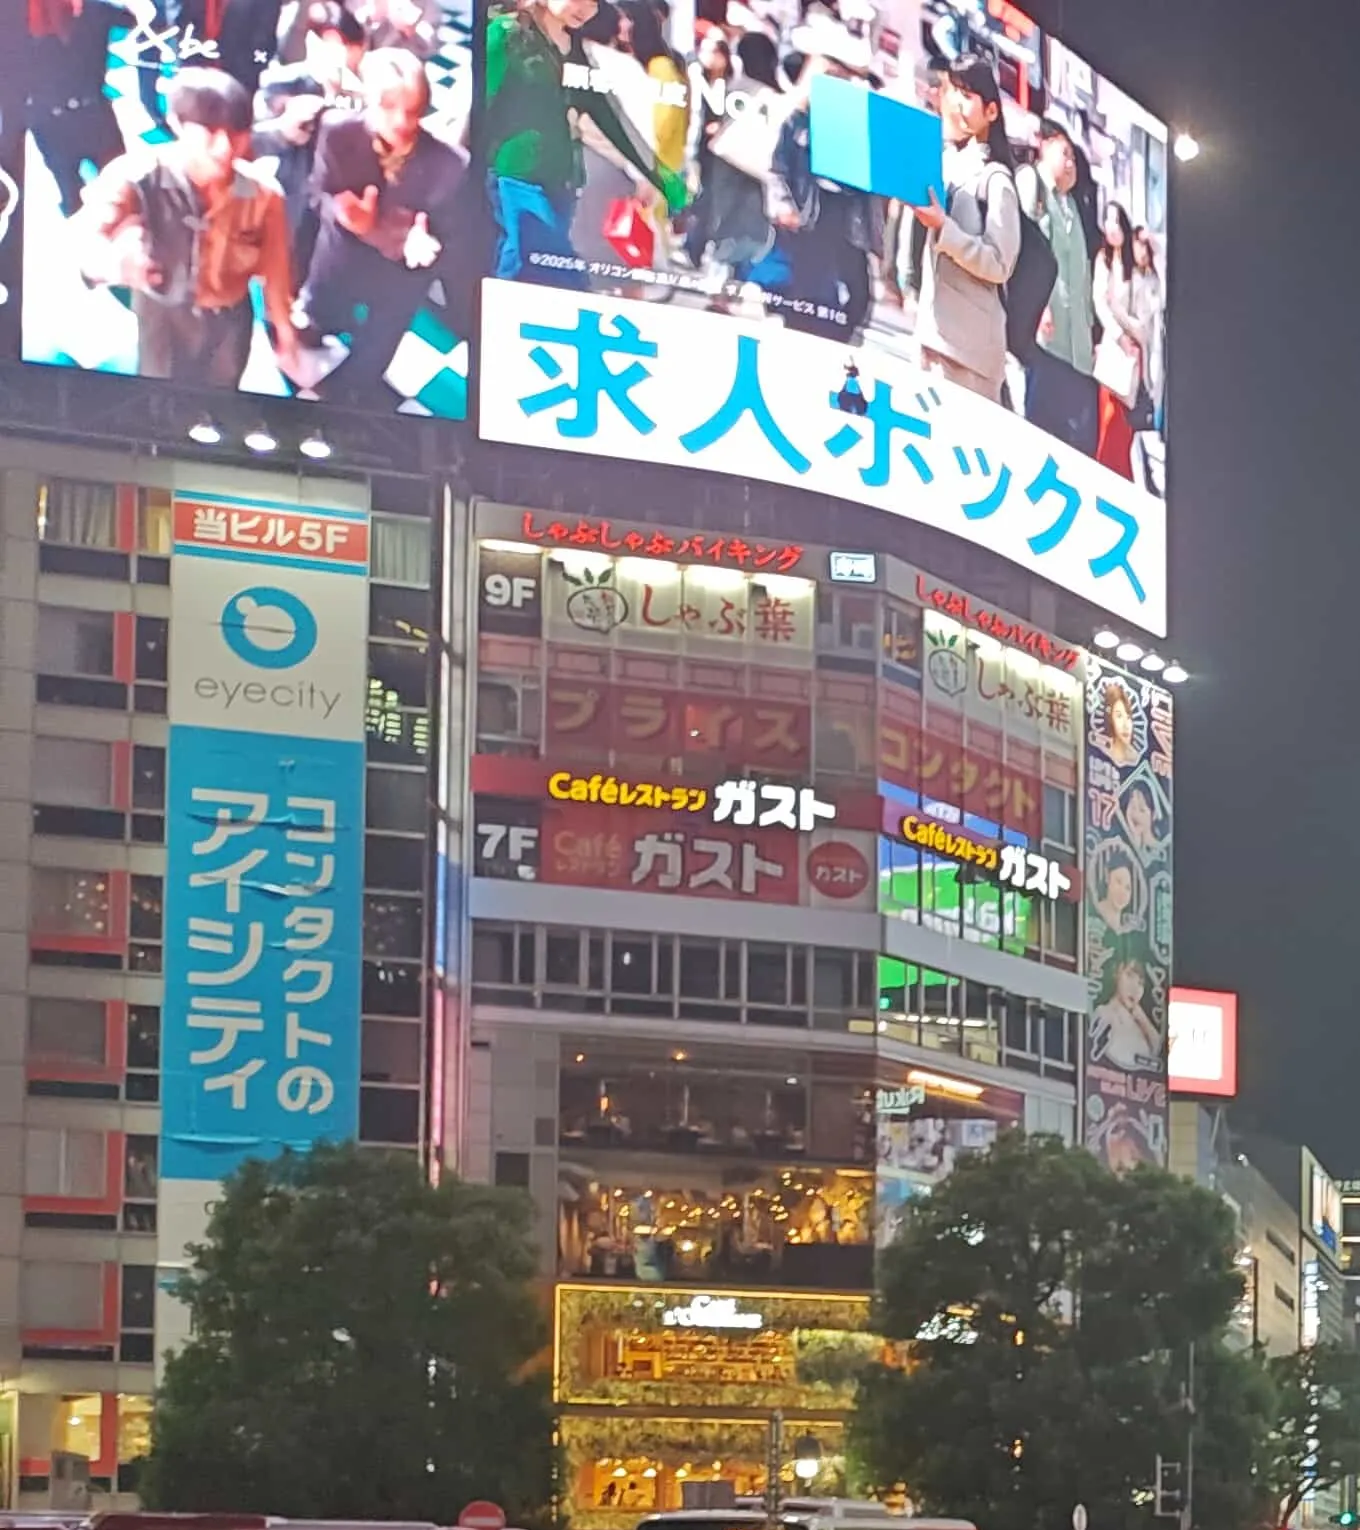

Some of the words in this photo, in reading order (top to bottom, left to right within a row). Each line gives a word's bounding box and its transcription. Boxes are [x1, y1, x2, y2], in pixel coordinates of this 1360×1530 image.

[518, 308, 1147, 604] 求人ボックス
[193, 508, 350, 553] 当ビル5F
[521, 511, 805, 571] しゃぶしゃぶバイキング
[484, 574, 536, 608] 9F
[641, 583, 796, 643] しゃぶ葉
[194, 676, 342, 719] eyecity
[548, 771, 707, 812] Caféレストラン
[712, 780, 836, 832] ガスト
[477, 823, 538, 861] 7F
[631, 832, 784, 894] ガスト
[999, 844, 1072, 900] ガスト
[186, 787, 271, 1111] アイシティ
[276, 795, 336, 1116] コンタクトの
